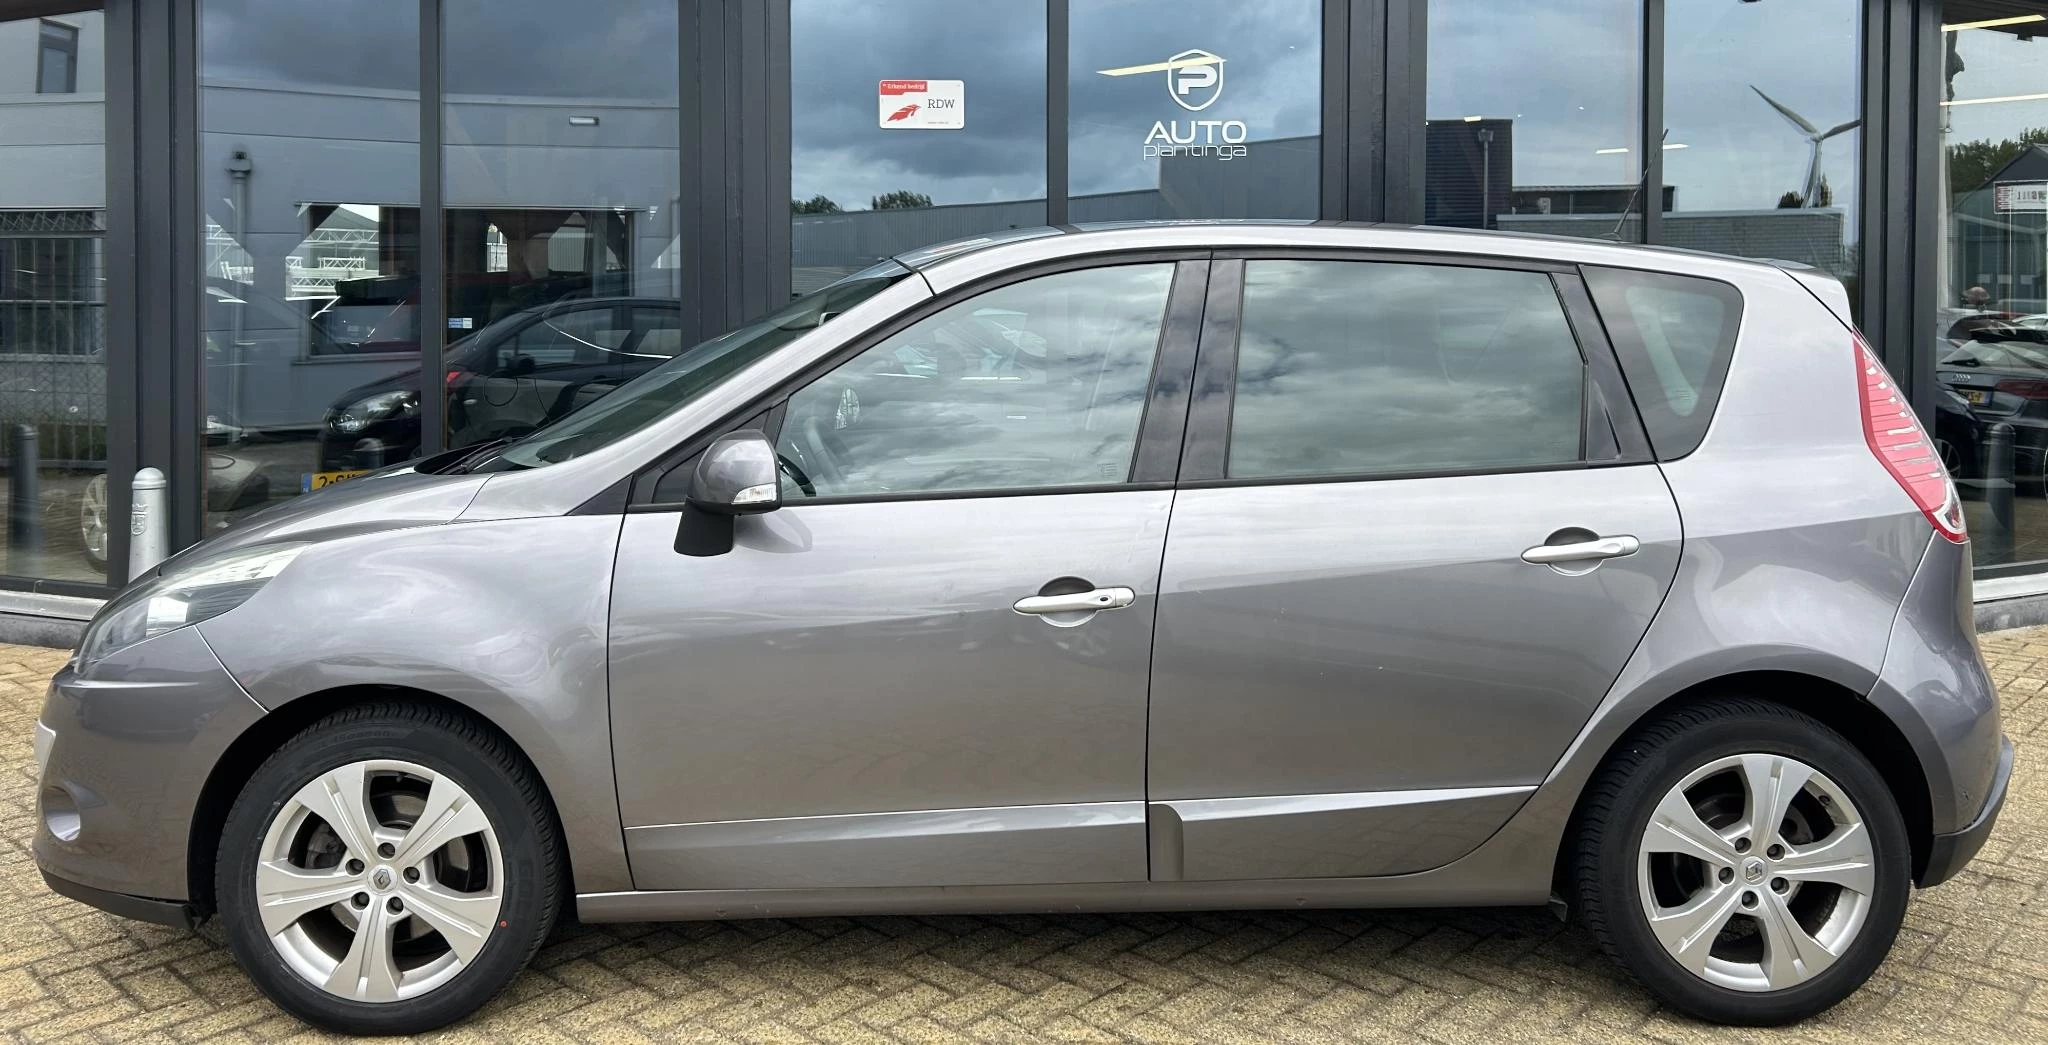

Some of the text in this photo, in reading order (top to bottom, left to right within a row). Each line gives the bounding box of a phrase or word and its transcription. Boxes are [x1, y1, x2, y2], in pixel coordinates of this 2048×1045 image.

[1178, 65, 1218, 95] P
[928, 99, 955, 109] RDW
[1144, 120, 1247, 144] AUTO
[1143, 143, 1247, 161] plantinga
